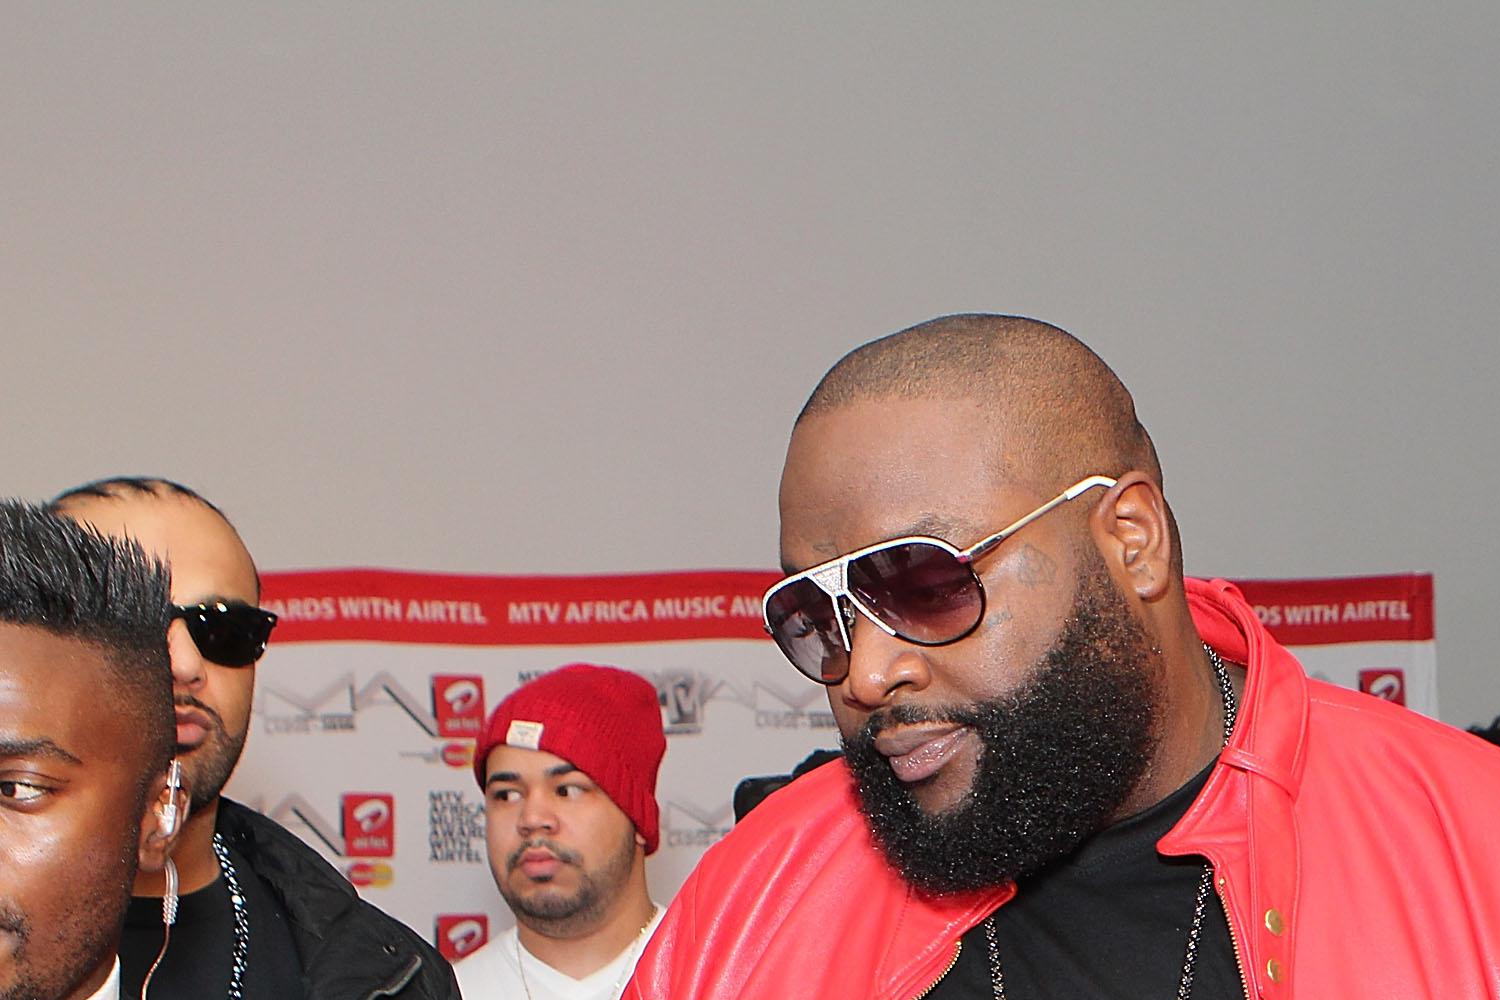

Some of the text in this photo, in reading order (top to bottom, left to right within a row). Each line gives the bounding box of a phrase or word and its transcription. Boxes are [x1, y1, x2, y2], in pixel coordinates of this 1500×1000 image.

[338, 597, 402, 620] WITH
[406, 600, 487, 624] AIRTEL
[508, 602, 561, 624] MTV
[565, 600, 648, 623] AFRICA
[653, 596, 726, 618] MUSIC
[1284, 605, 1339, 625] WITH
[1342, 601, 1411, 623] AIRTEL
